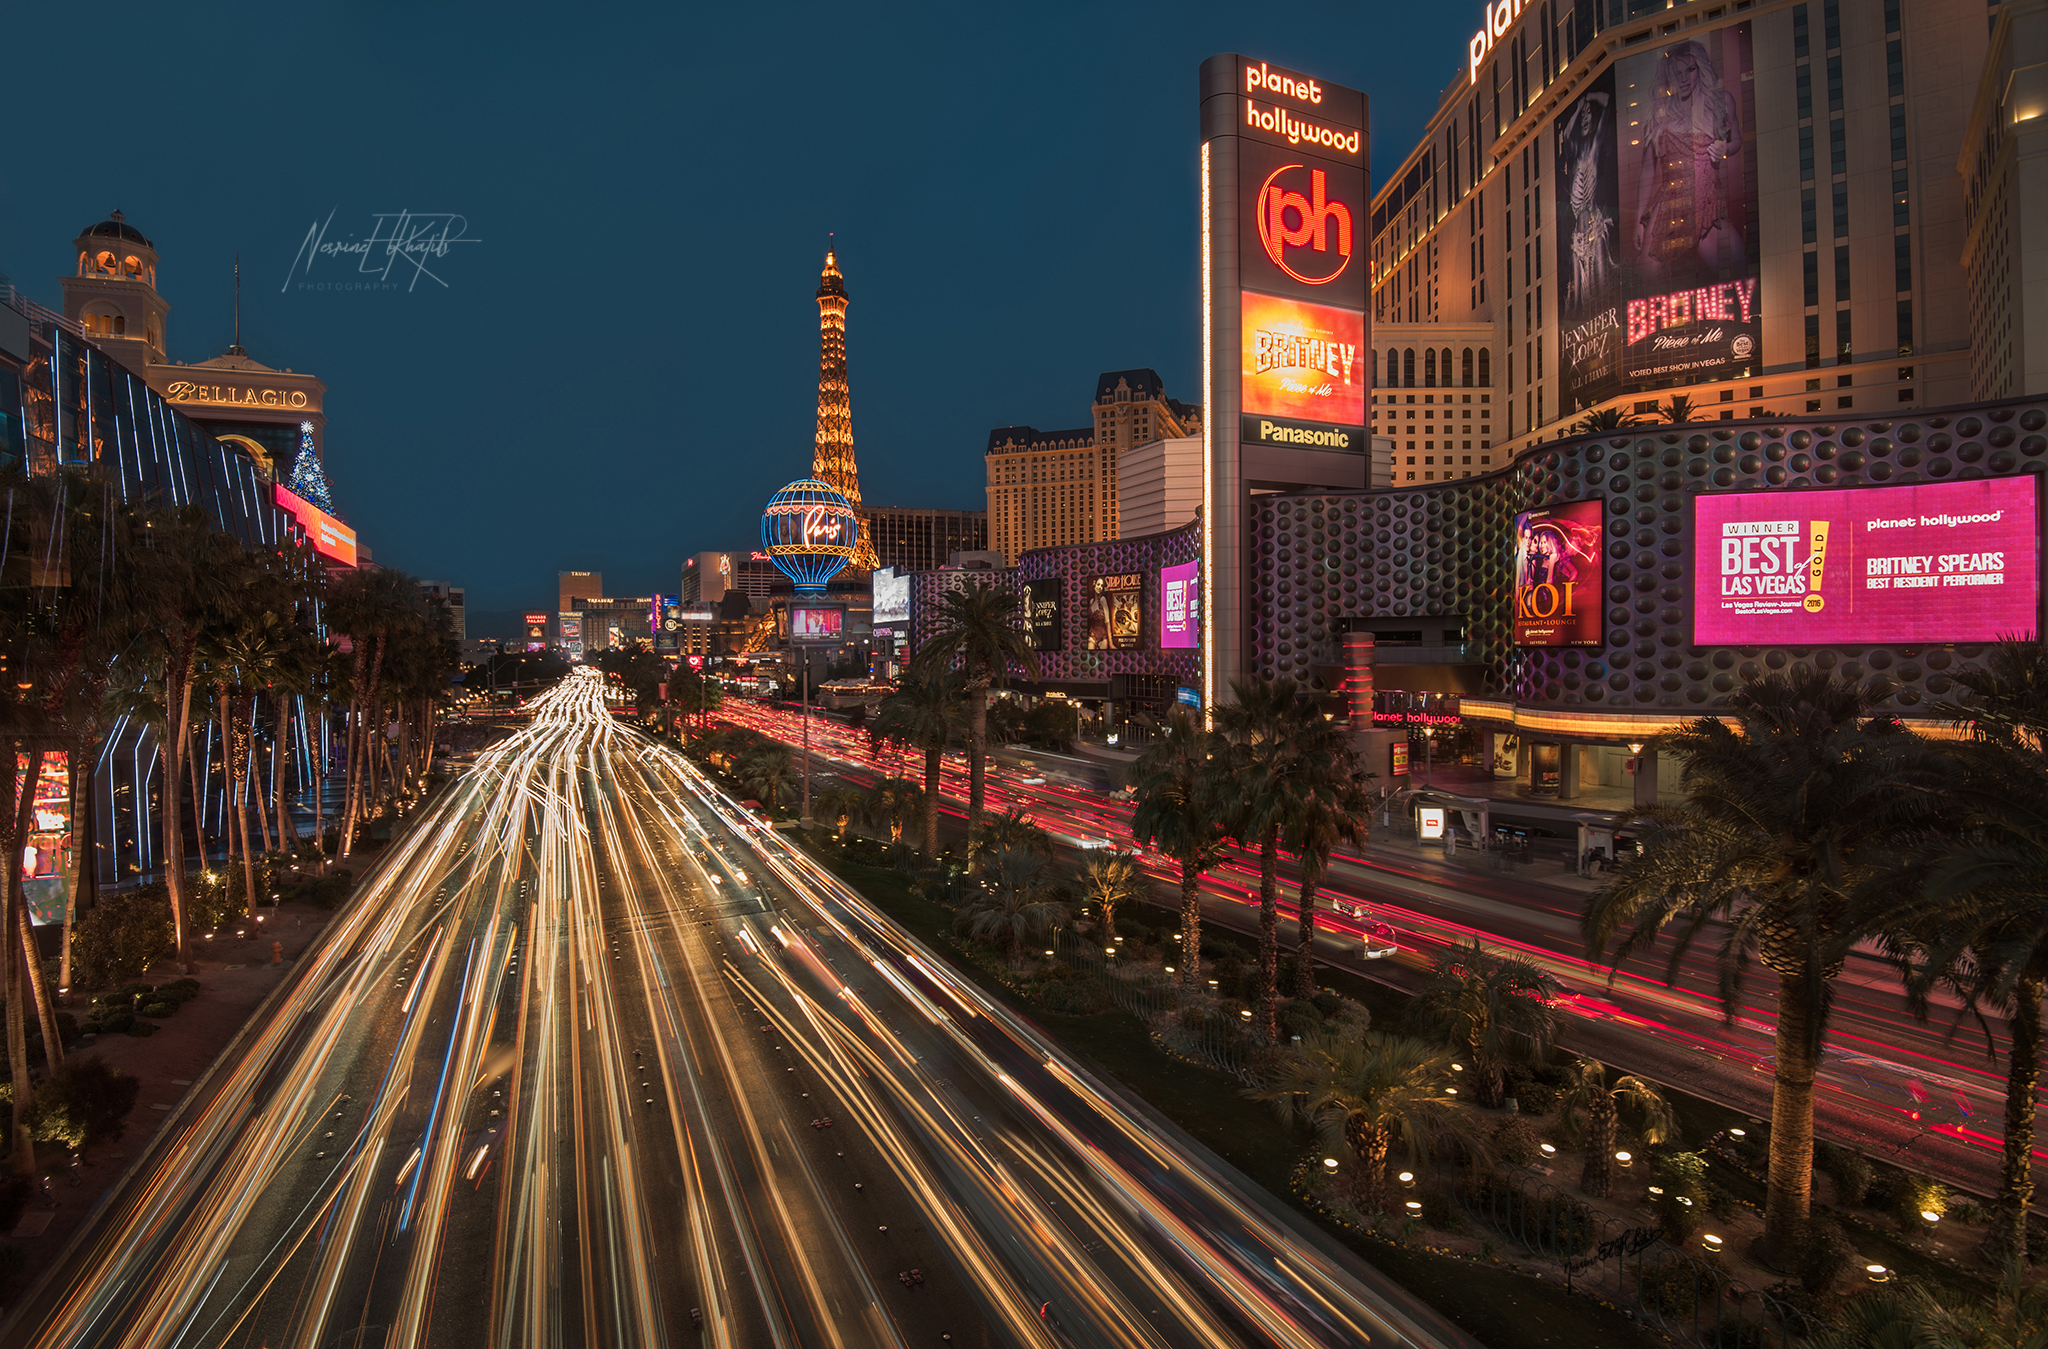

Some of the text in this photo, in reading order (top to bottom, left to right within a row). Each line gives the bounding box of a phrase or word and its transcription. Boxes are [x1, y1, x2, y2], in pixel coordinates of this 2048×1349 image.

[1247, 62, 1321, 104] planet
[1247, 99, 1359, 154] hollywood
[1269, 169, 1352, 261] ph
[1627, 278, 1756, 346] BRITNEY
[1561, 307, 1620, 359] JENNIFER
[1652, 327, 1724, 352] Piece of Me
[1255, 329, 1356, 387] BRITNEY
[1572, 332, 1610, 365] LOPEZ
[1589, 365, 1609, 385] HAVE
[1629, 369, 1652, 378] VOTED
[1653, 366, 1669, 374] BEST
[1669, 363, 1690, 372] SHOW
[1691, 362, 1699, 370] IN
[1699, 357, 1726, 367] VEGAS
[1279, 378, 1307, 394] Piece
[1315, 383, 1333, 397] Me
[1260, 420, 1349, 448] Panasonic
[803, 504, 841, 549] Paris
[1728, 523, 1795, 534] WINNER
[1867, 510, 2001, 532] planet hollywood
[1721, 536, 1800, 575] BEST
[1794, 552, 1820, 580] of
[1812, 534, 1824, 577] GOLD
[1867, 552, 2004, 575] BRITNEY SPEARS
[1721, 575, 1806, 595] LAS VEGAS
[1867, 573, 2004, 589] BEST RESIDENT PERFORMER
[1518, 581, 1577, 619] KOI
[1734, 601, 1753, 609] Vegas
[1754, 600, 1802, 608] Review-Journal
[1807, 599, 1821, 608] 2016
[1372, 711, 1403, 722] lanet
